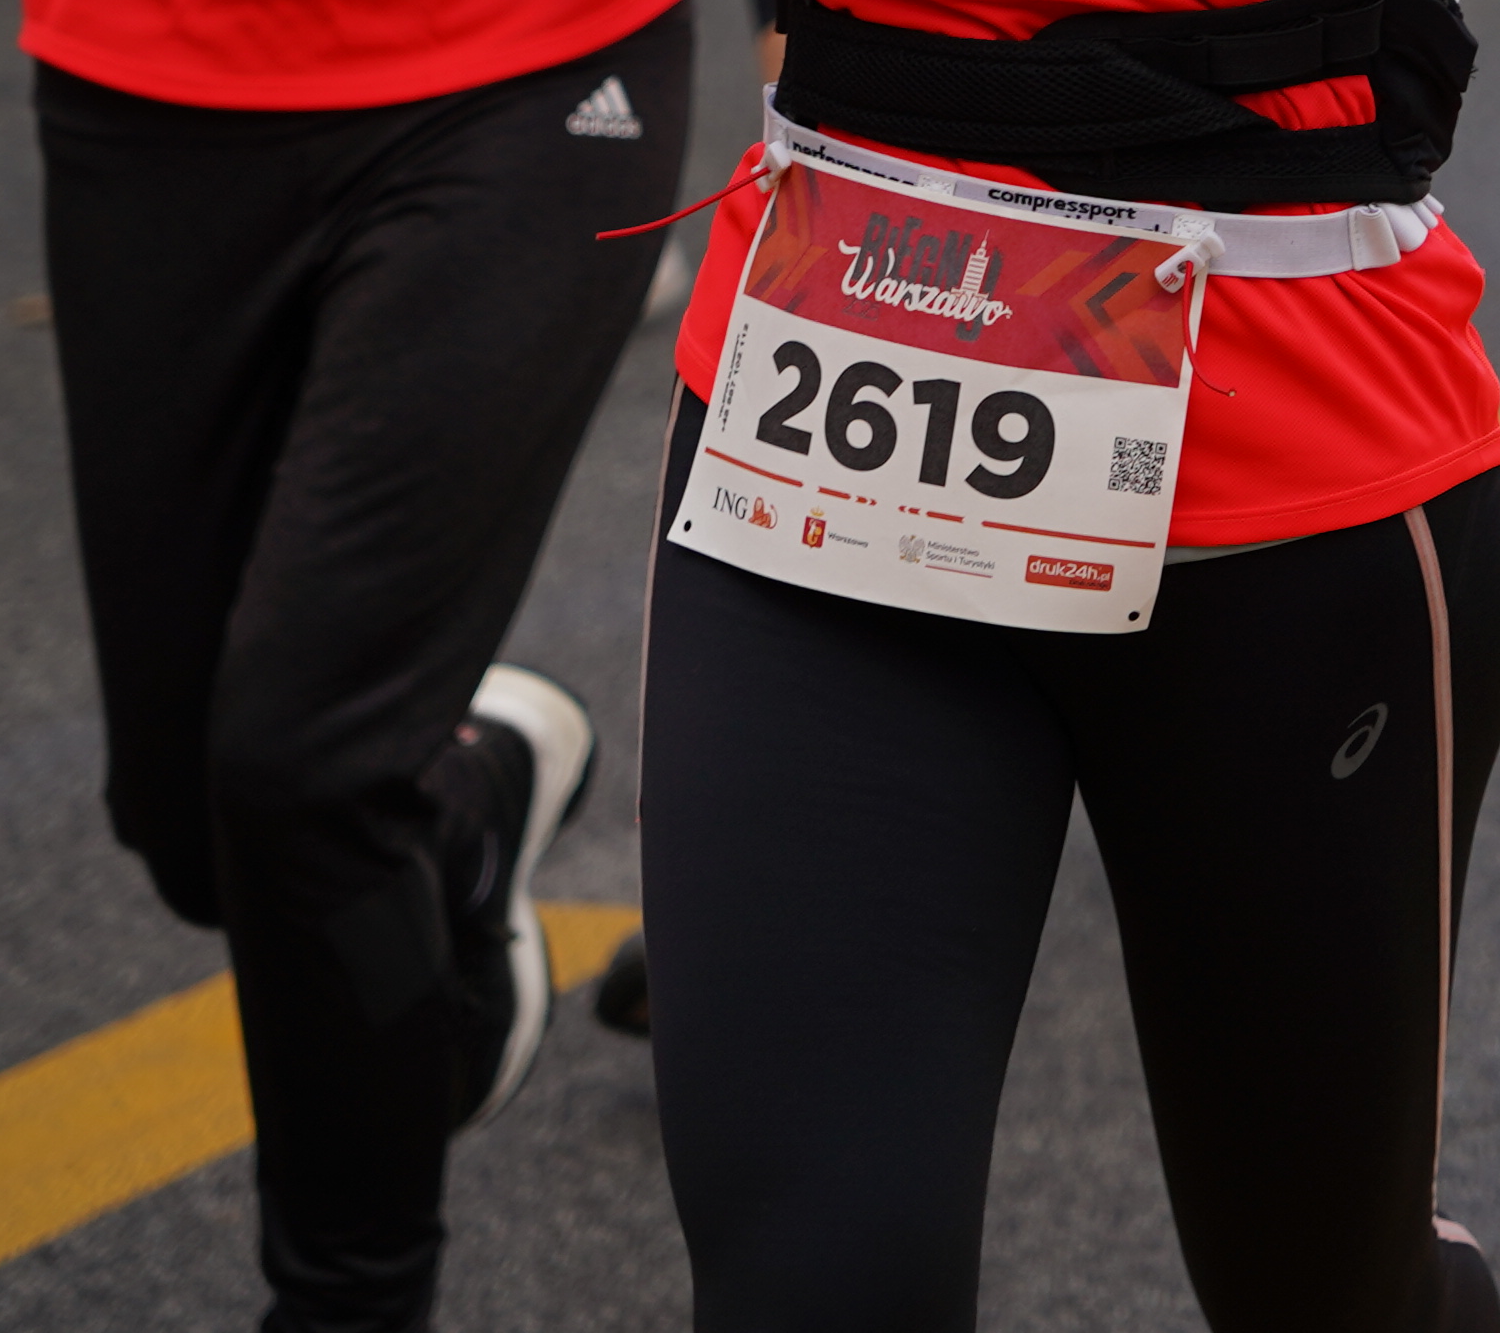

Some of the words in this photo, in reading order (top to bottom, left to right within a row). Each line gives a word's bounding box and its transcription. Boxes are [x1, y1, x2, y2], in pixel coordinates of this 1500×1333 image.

[988, 187, 1137, 221] compressport
[838, 239, 1013, 326] Warszawo
[756, 340, 1056, 499] 2619
[713, 486, 748, 521] ING
[1029, 559, 1111, 582] druk24h.pl
